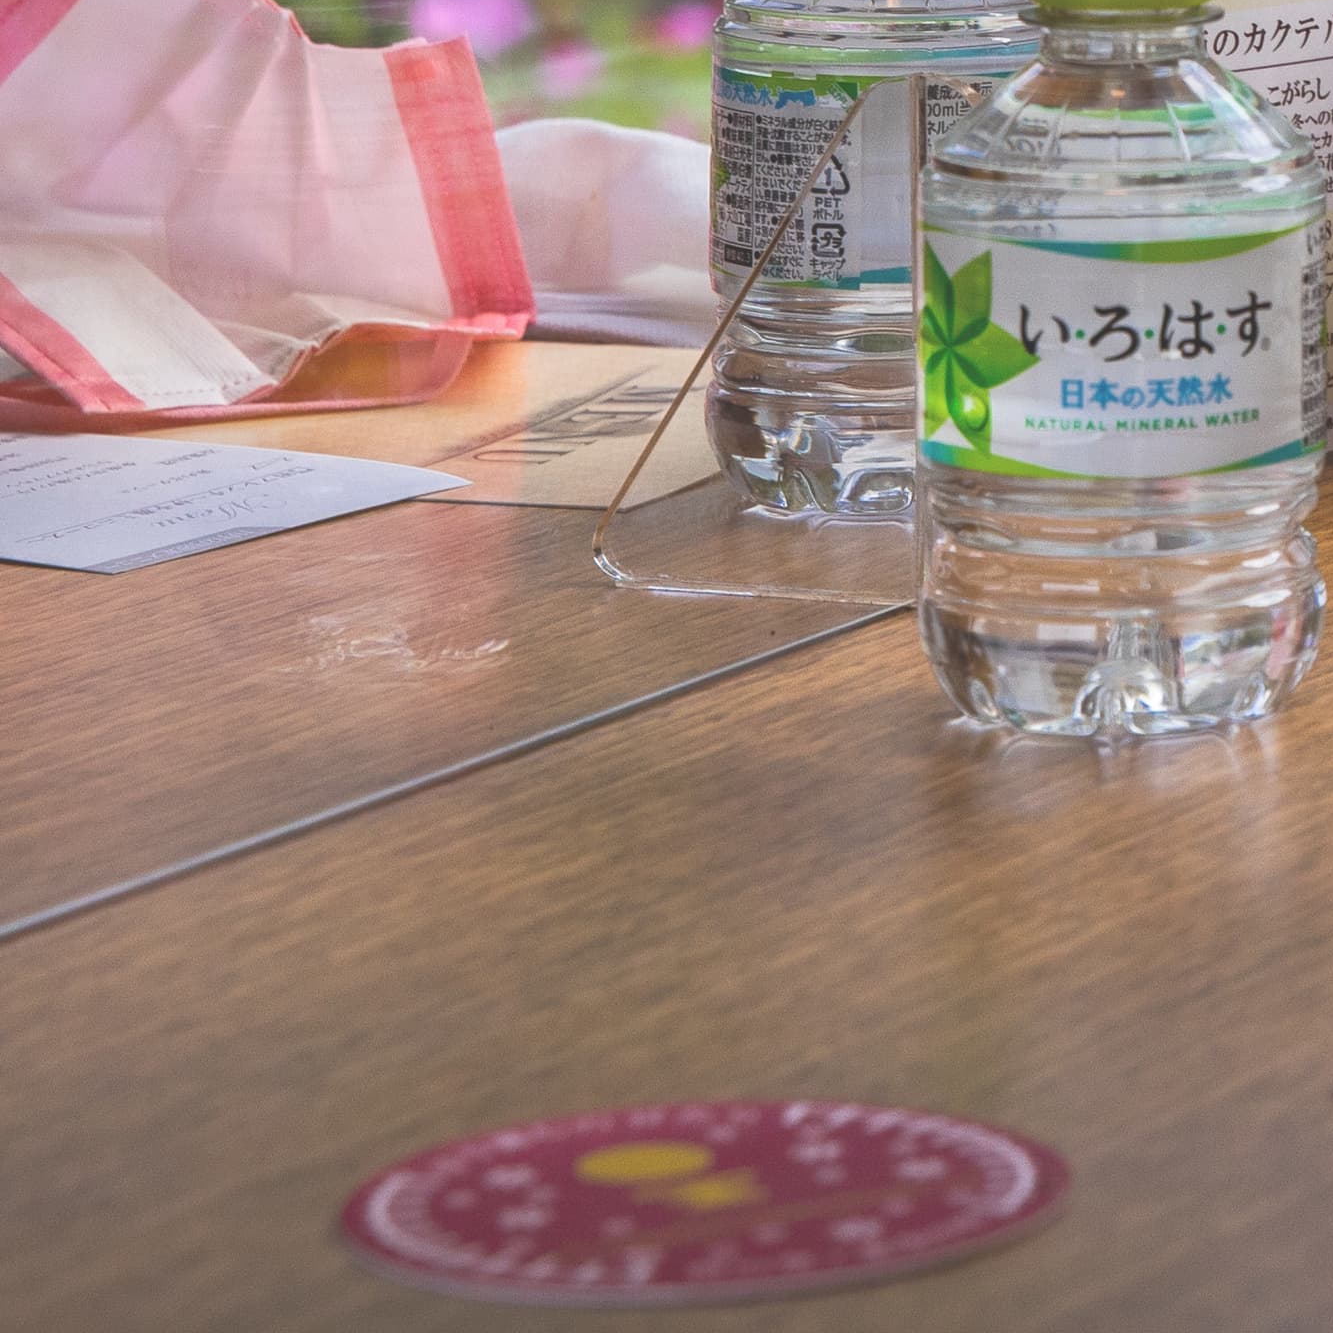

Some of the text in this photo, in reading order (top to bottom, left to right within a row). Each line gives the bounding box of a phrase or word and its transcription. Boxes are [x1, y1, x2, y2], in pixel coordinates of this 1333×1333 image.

[814, 197, 842, 209] PET
[812, 209, 844, 221] ボトル
[820, 231, 842, 248] プラ
[809, 257, 846, 271] キャップ
[812, 269, 842, 282] ラベル
[1061, 372, 1233, 411] 日本の天然水
[1024, 408, 1260, 432] NATURAL MINERAL WATER
